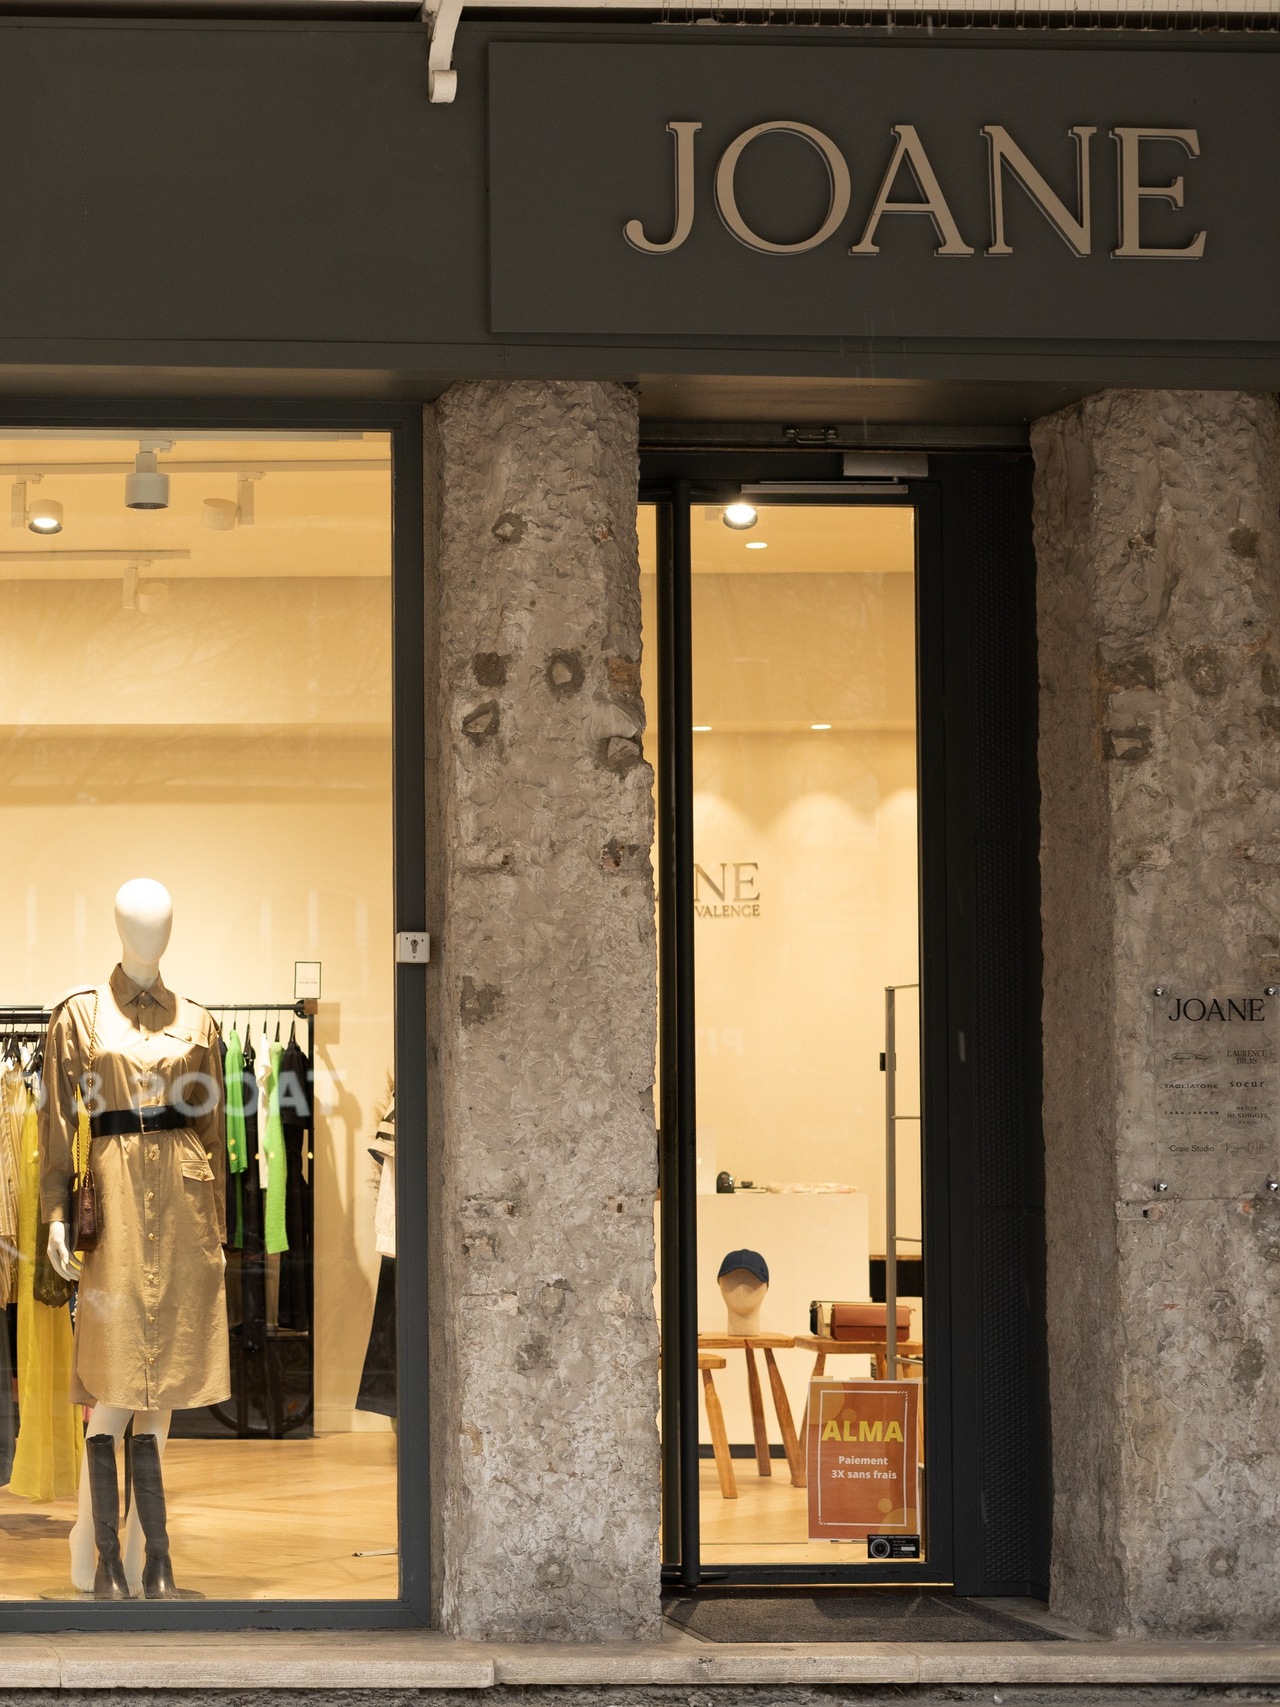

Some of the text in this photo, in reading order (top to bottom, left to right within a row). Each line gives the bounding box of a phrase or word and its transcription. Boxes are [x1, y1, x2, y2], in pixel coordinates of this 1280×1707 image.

[623, 119, 1208, 259] JOANE
[694, 862, 761, 903] NE
[694, 904, 761, 918] VALENCE
[1168, 997, 1266, 1022] JOANE
[1227, 1049, 1267, 1057] LAURENCE
[1191, 1144, 1215, 1152] Studio
[821, 1420, 904, 1443] ALMA
[838, 1455, 889, 1466] Paiement
[831, 1469, 897, 1480] 3X sans frais
